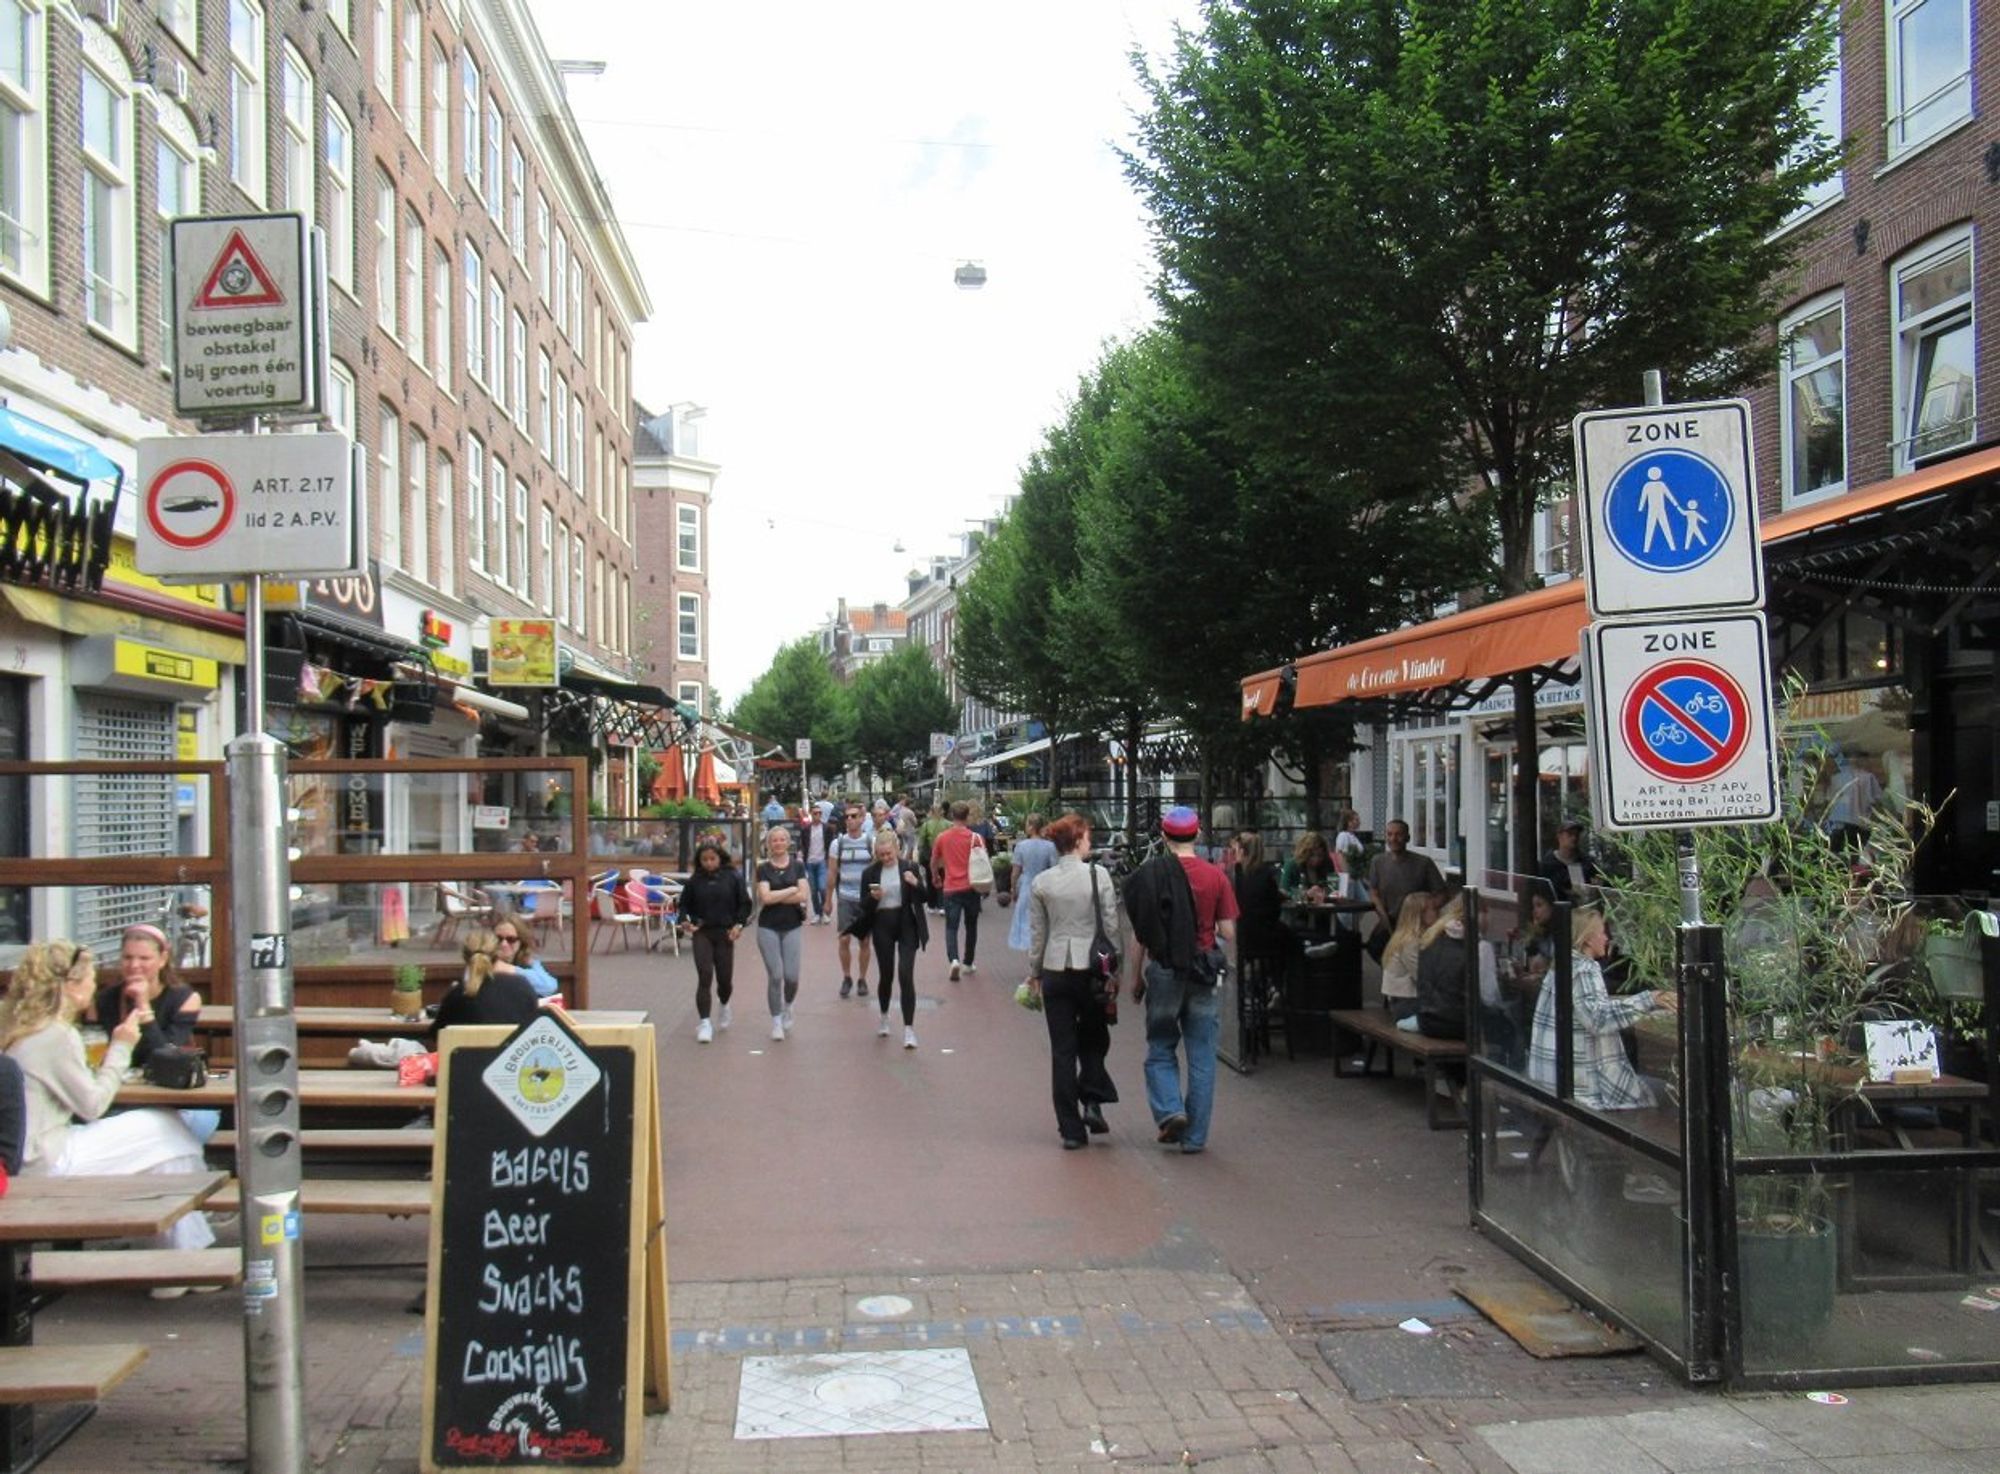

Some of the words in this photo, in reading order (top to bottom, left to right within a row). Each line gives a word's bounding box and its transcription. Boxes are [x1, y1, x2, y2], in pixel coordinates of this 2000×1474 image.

[185, 318, 293, 336] beweegbaar
[203, 338, 276, 356] obstakel
[184, 364, 204, 382] bij
[210, 363, 259, 381] groen
[265, 358, 295, 374] één
[204, 381, 276, 397] voertuig
[1627, 420, 1700, 443] ZONE
[252, 478, 293, 493] ART.
[300, 478, 334, 493] 2.17
[246, 513, 266, 528] lid
[273, 513, 284, 527] 2
[290, 512, 340, 526] A.P.V.
[1643, 631, 1717, 653] ZONE
[1721, 782, 1748, 792] APV
[1722, 793, 1762, 803] 14020
